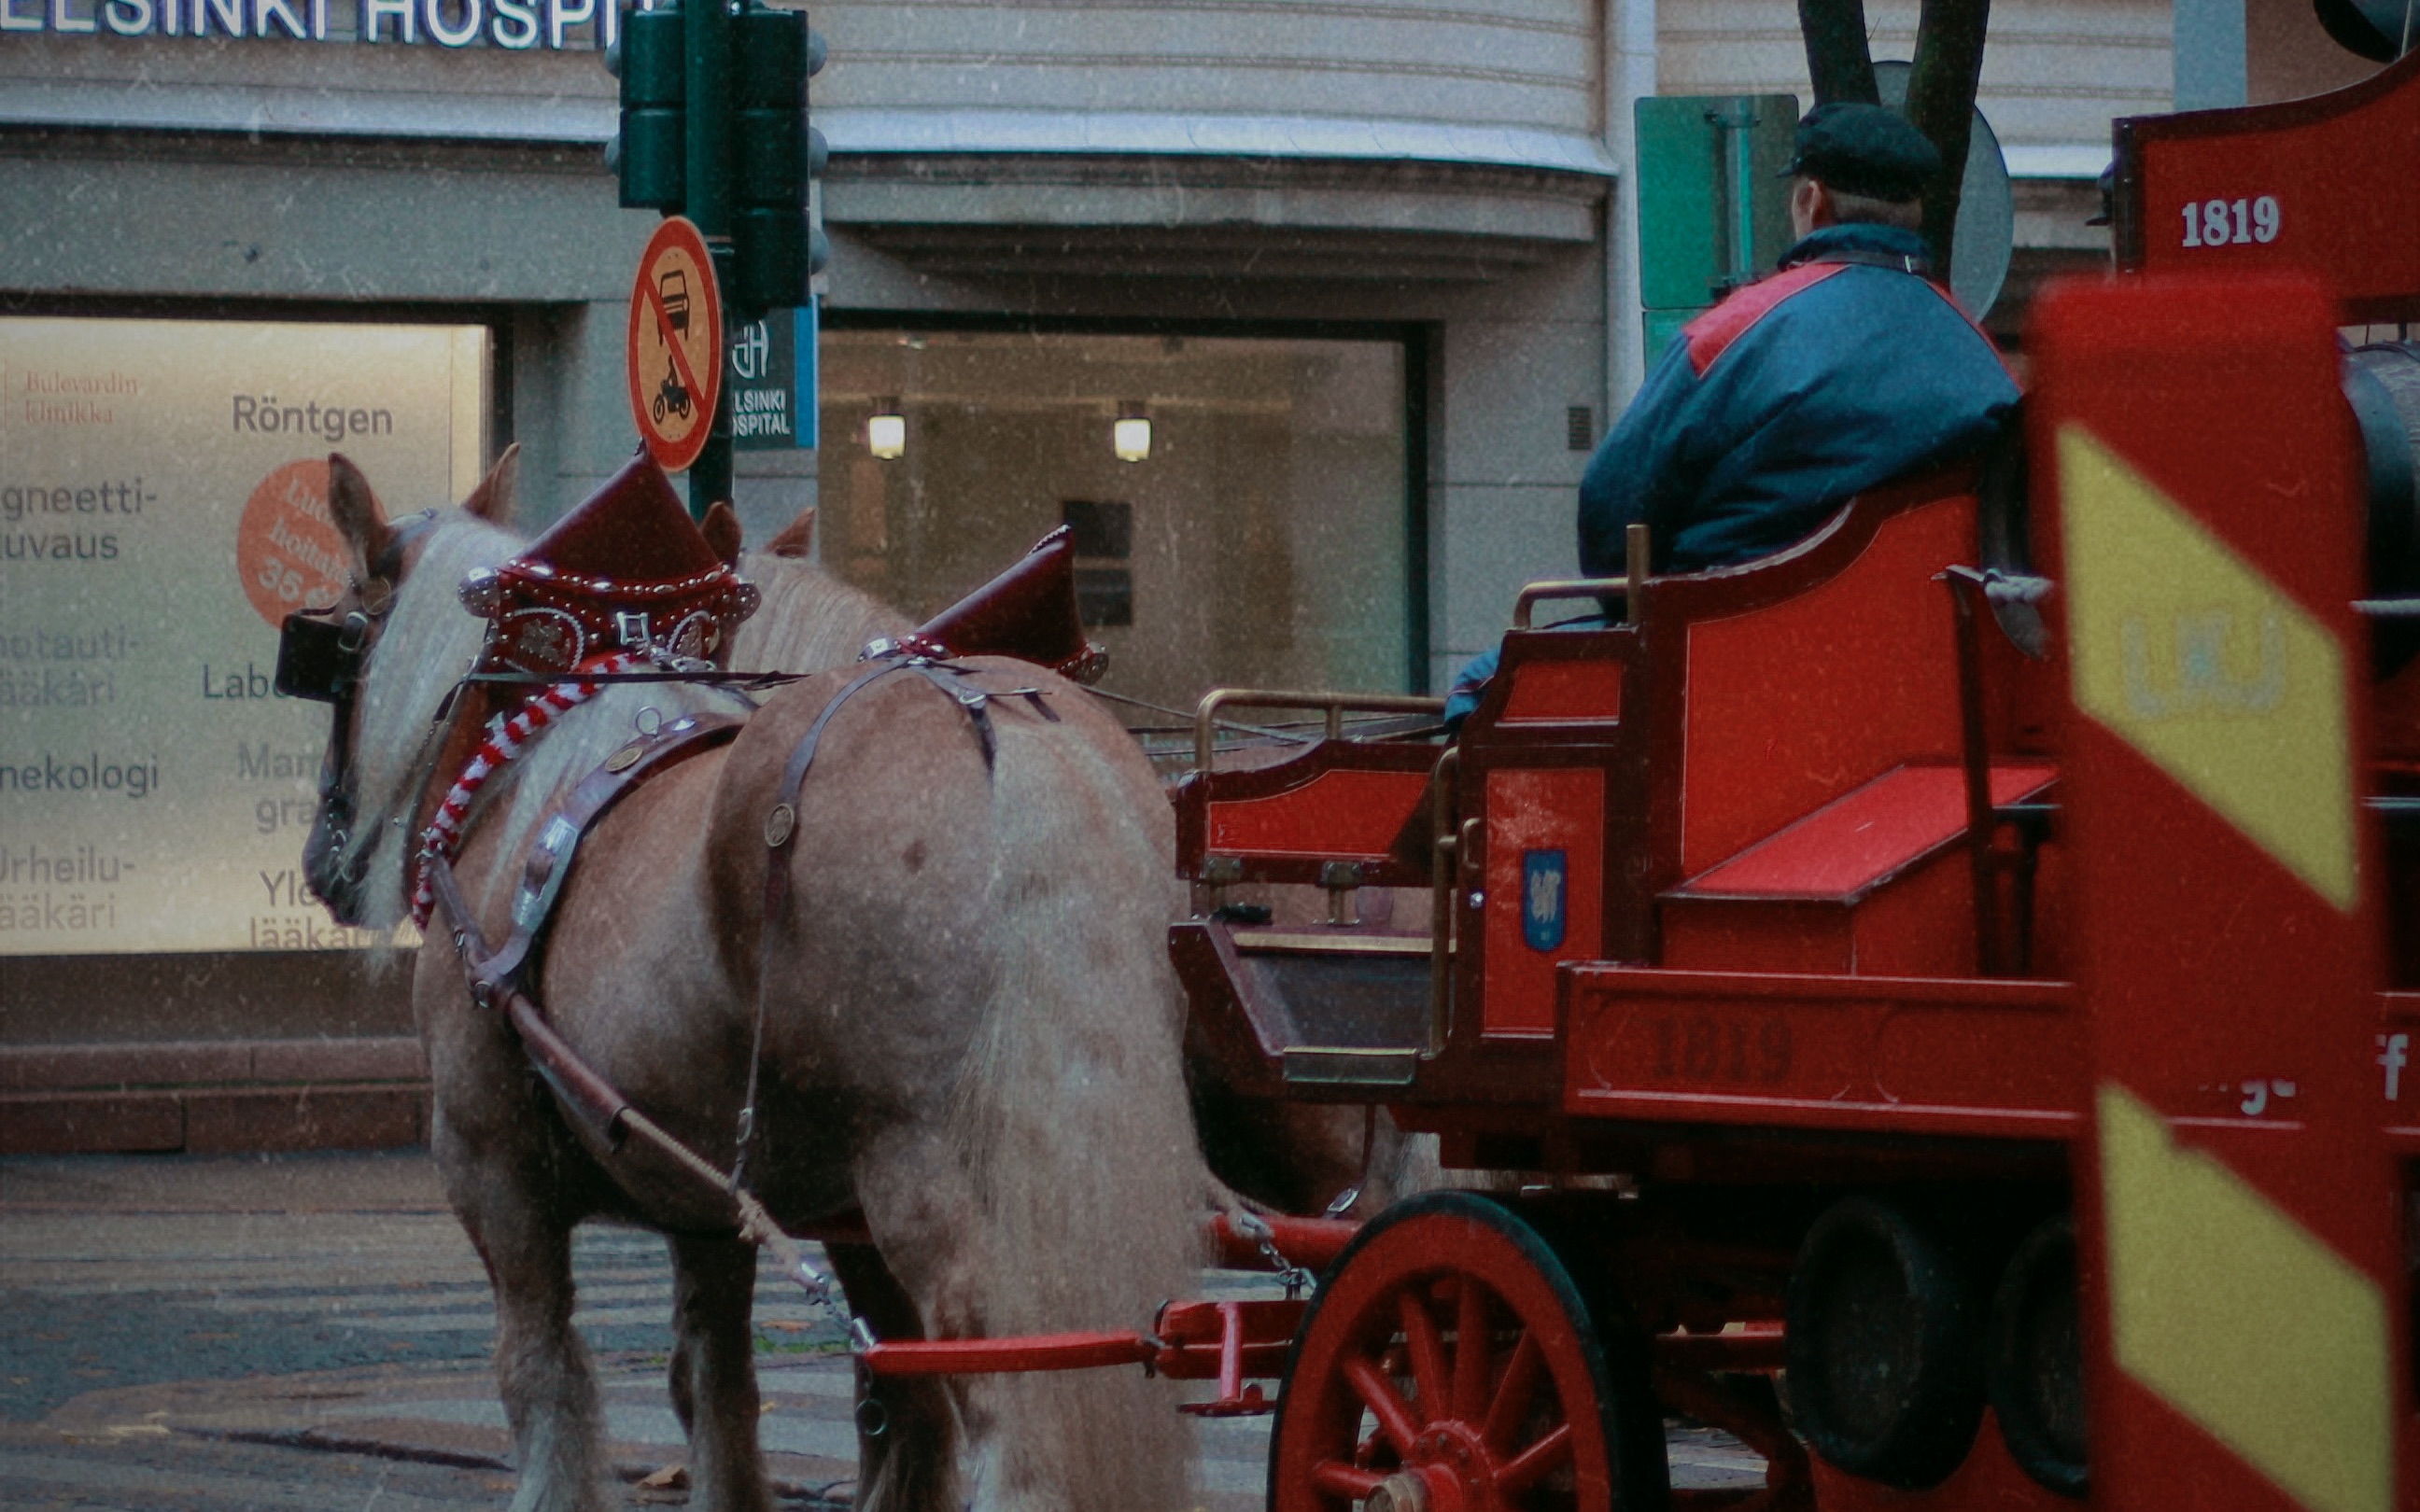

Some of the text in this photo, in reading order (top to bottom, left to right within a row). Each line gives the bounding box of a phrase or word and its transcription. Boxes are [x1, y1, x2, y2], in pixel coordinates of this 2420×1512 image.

[367, 0, 651, 48] HOSPI
[2181, 195, 2280, 247] 1819
[232, 394, 393, 441] Röntgen
[3, 477, 157, 521] gneetti-
[258, 555, 304, 604] 35
[0, 752, 159, 798] nekologi
